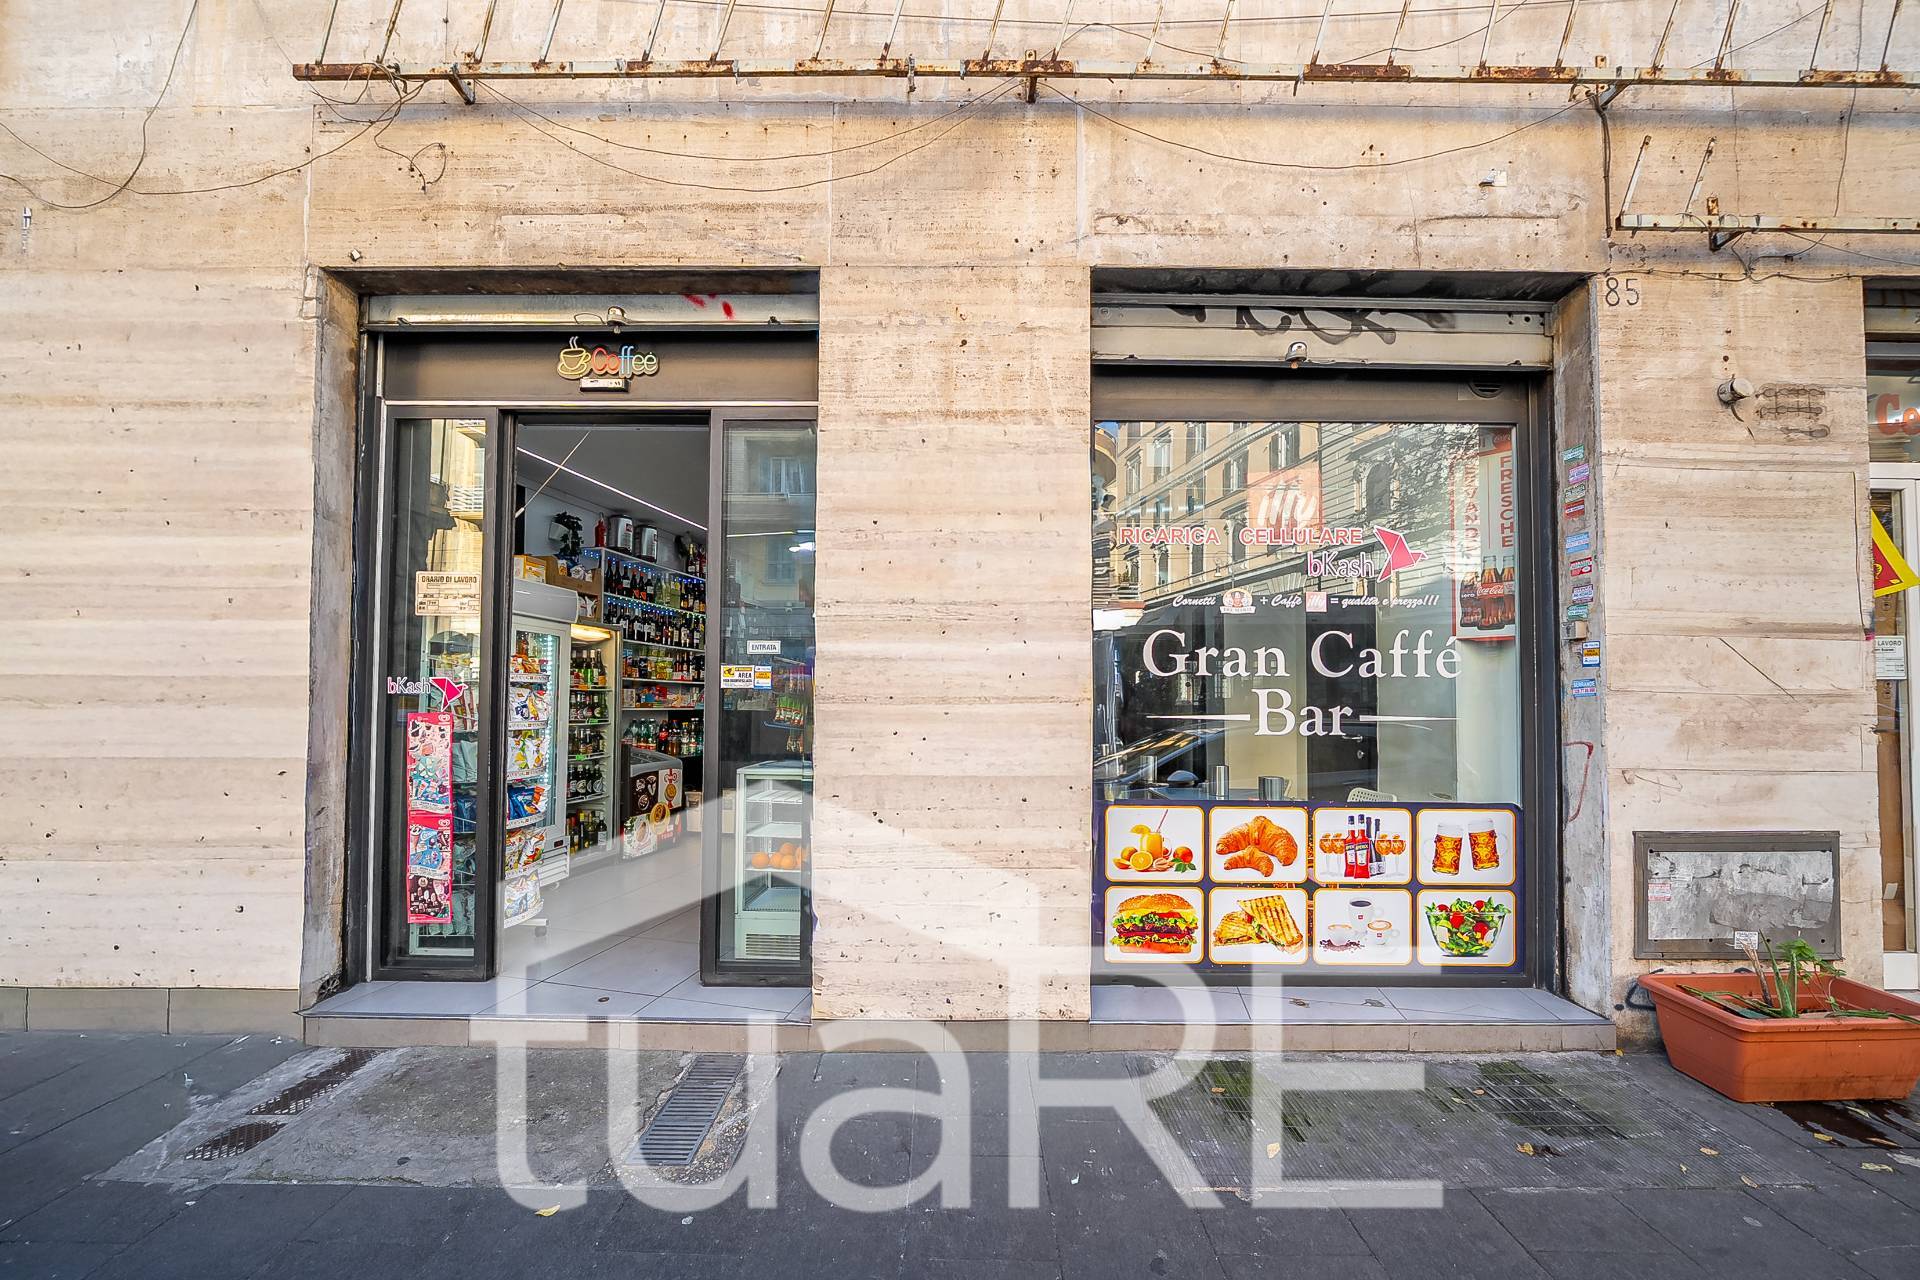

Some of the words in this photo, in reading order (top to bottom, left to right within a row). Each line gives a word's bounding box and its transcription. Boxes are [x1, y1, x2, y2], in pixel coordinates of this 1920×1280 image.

[1605, 277, 1639, 306] 85
[592, 345, 657, 376] Coffee
[1499, 456, 1515, 548] FRESCHE
[1120, 527, 1220, 545] RICARICA
[1239, 527, 1364, 546] CELLULARE
[1307, 551, 1375, 577] bKash
[1172, 595, 1216, 607] Cornetti
[751, 643, 777, 651] ENTRATA
[1142, 629, 1290, 678] Gran
[1310, 629, 1463, 679] Caffé
[387, 676, 431, 694] bKash
[1251, 687, 1353, 737] Bar
